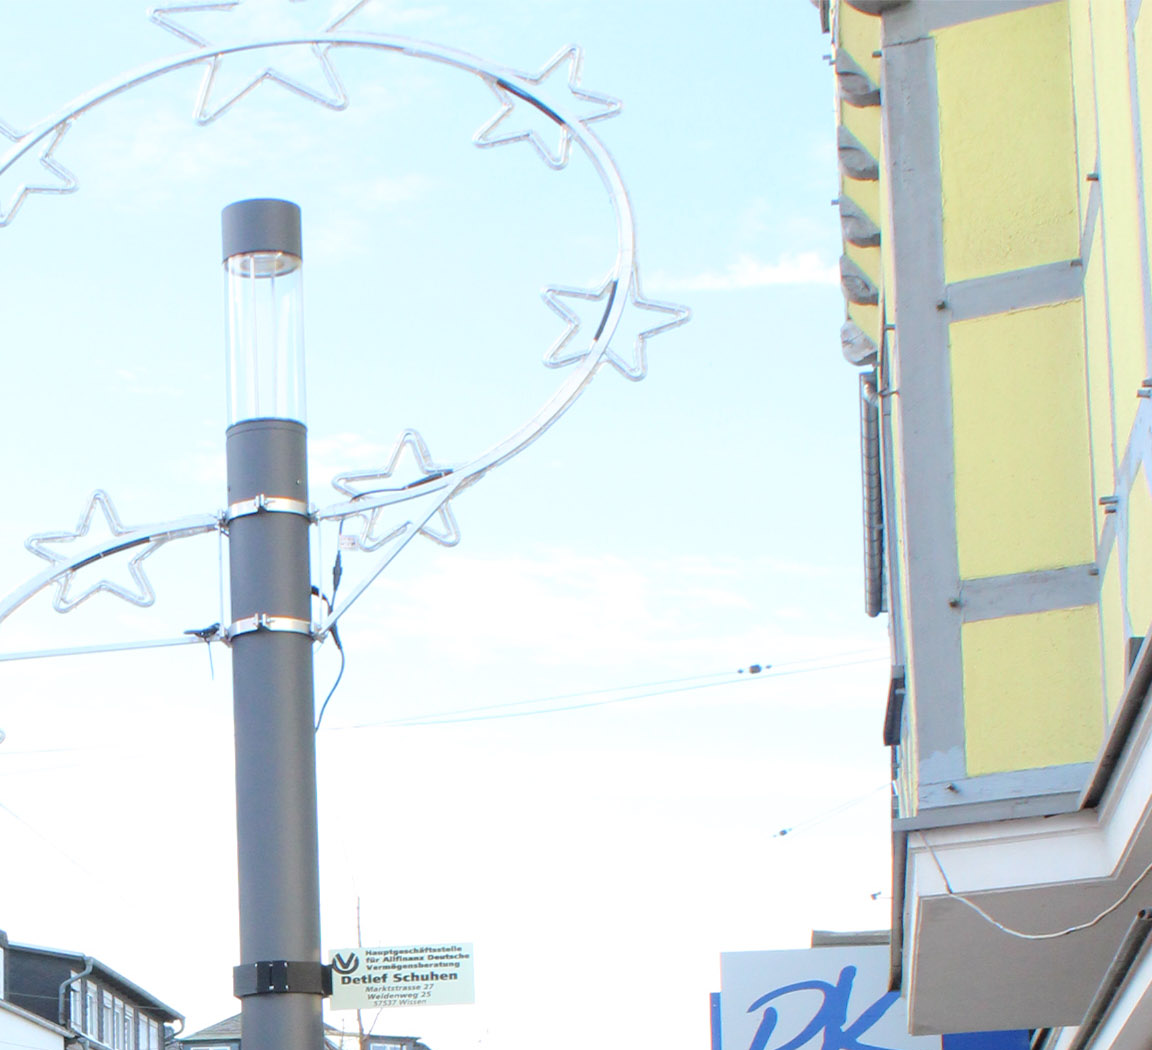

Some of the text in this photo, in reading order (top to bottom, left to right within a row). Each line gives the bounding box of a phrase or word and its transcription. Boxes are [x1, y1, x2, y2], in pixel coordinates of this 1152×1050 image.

[365, 945, 462, 957] Hauptgeschäftsstelle
[427, 953, 470, 961] Deutsche
[366, 961, 460, 971] Vermögensberatung
[341, 971, 458, 985] Detlef Schuhen
[365, 984, 421, 992] Marktstrasse
[367, 991, 418, 1000] Weidenweg
[398, 998, 427, 1006] Wissen
